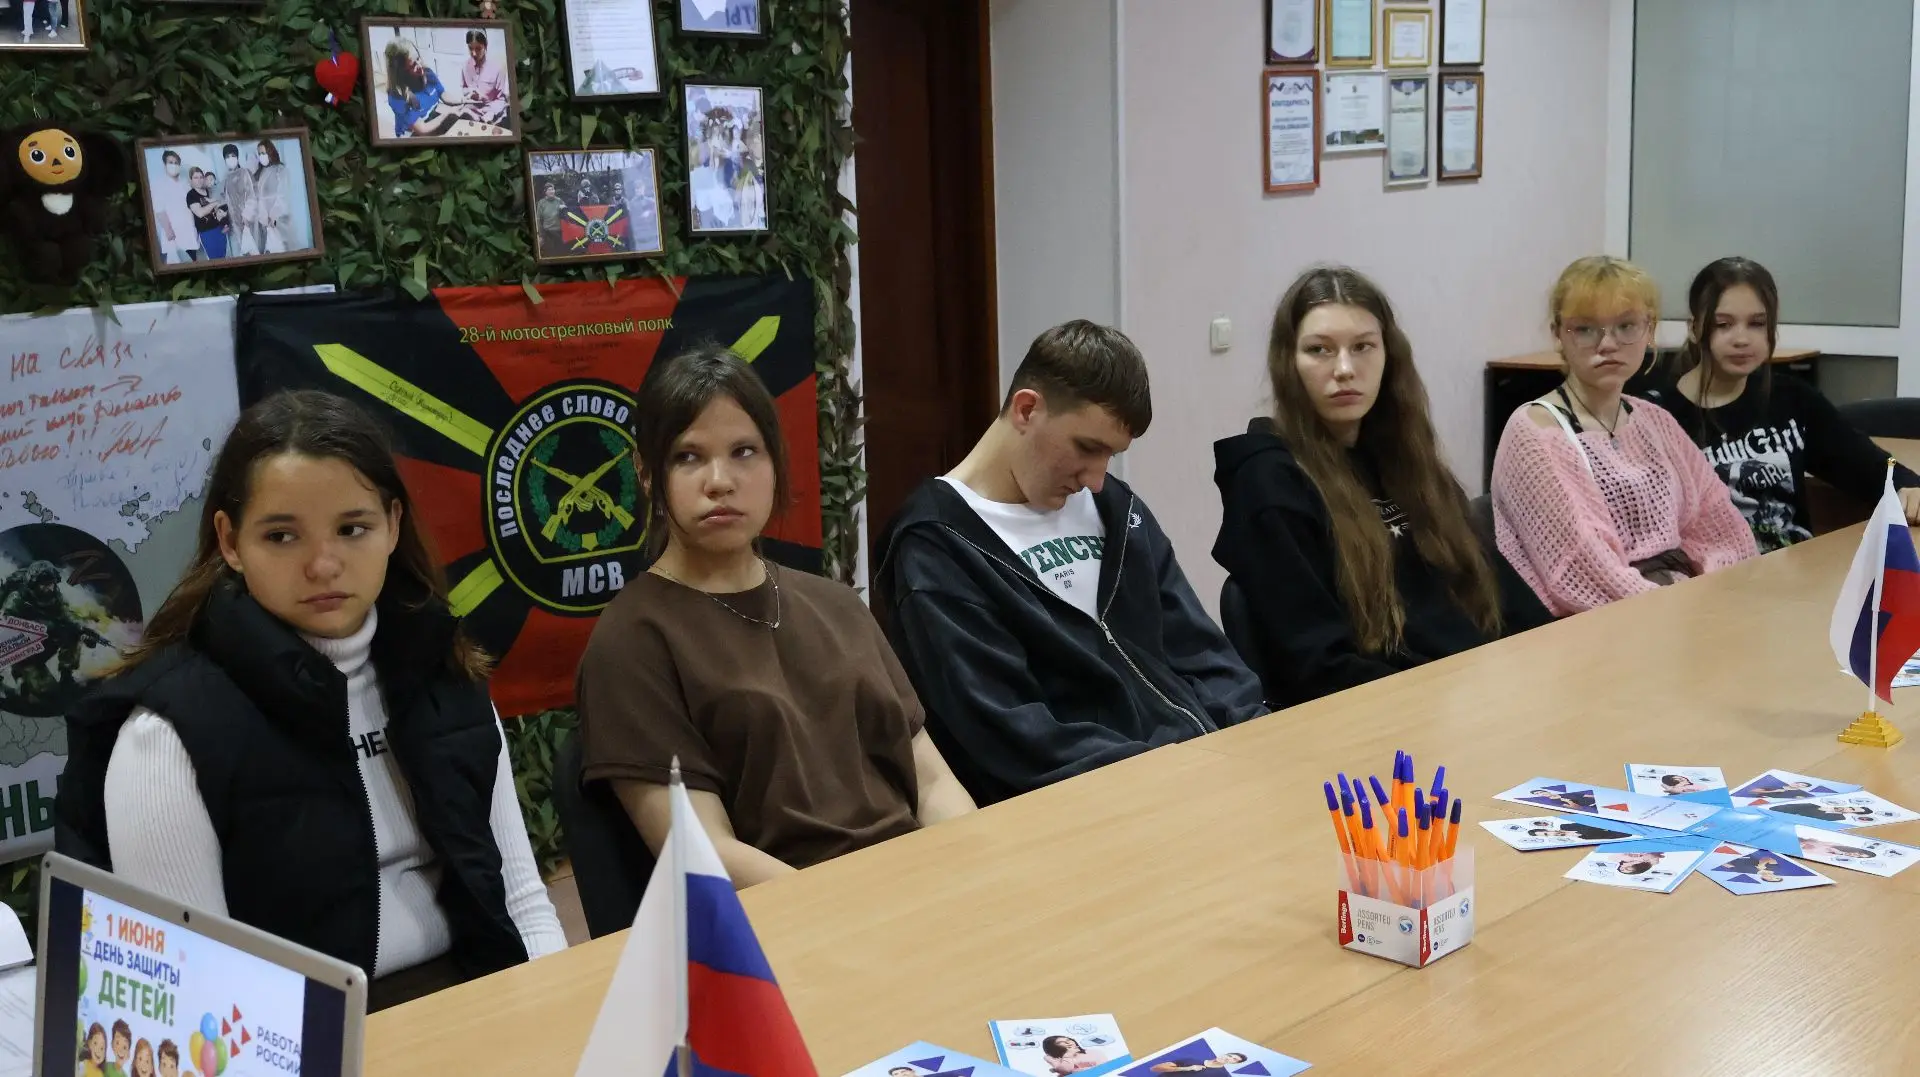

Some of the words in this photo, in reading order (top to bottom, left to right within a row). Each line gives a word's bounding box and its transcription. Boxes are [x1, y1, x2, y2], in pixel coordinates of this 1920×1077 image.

[459, 325, 496, 343] 28-й
[501, 317, 634, 341] мотострелковый
[638, 317, 674, 332] полк
[496, 404, 556, 538] последнее
[562, 395, 629, 424] слово
[562, 561, 625, 598] МСВ
[1054, 568, 1075, 580] PARIS
[8, 618, 45, 632] ДОНБАСС
[1340, 902, 1348, 934] Berlingo
[1357, 908, 1391, 926] ASSORTED
[1357, 918, 1375, 931] PENS
[106, 912, 113, 937] 1
[118, 915, 166, 955] ИЮНЯ
[93, 940, 124, 966] ДЕНЬ
[127, 950, 180, 987] ЗАЩИТЫ
[98, 969, 176, 1027] ДЕТЕЙ!
[257, 1026, 302, 1057] РАБОТА
